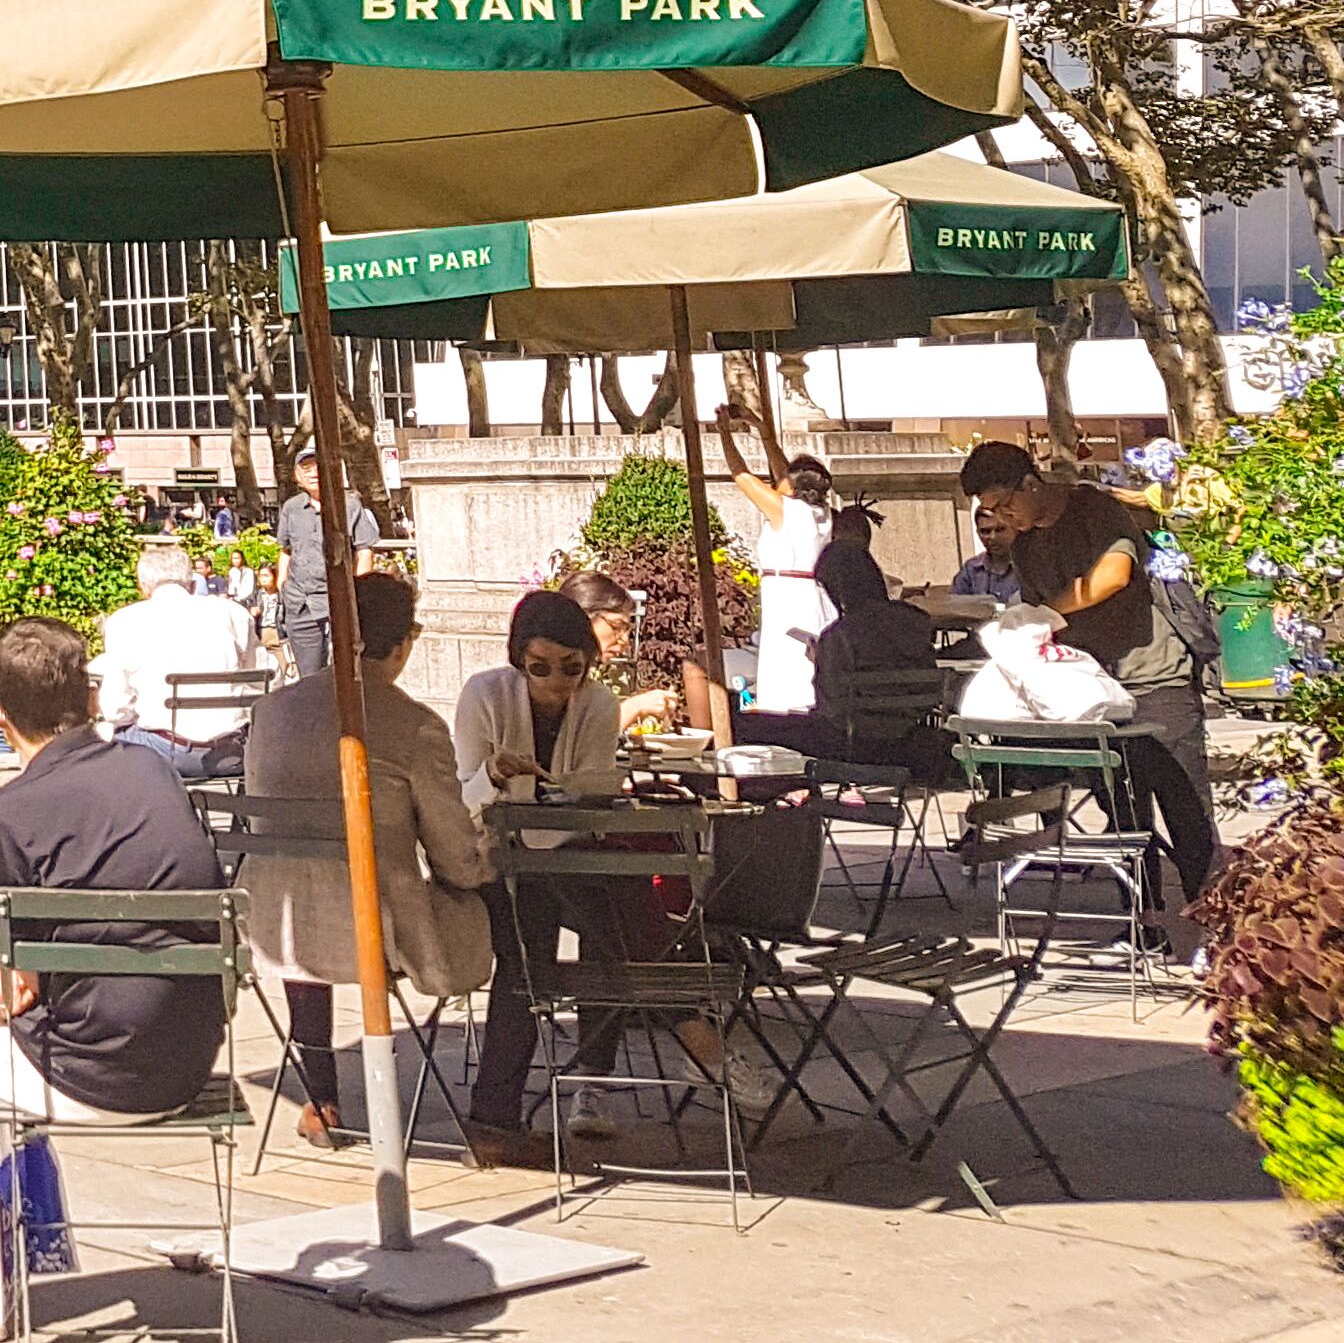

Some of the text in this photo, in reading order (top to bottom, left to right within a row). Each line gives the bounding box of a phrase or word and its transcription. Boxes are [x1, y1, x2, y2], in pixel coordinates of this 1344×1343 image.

[937, 228, 1096, 251] BRYANT PARK
[324, 246, 491, 283] BRYANT PARK
